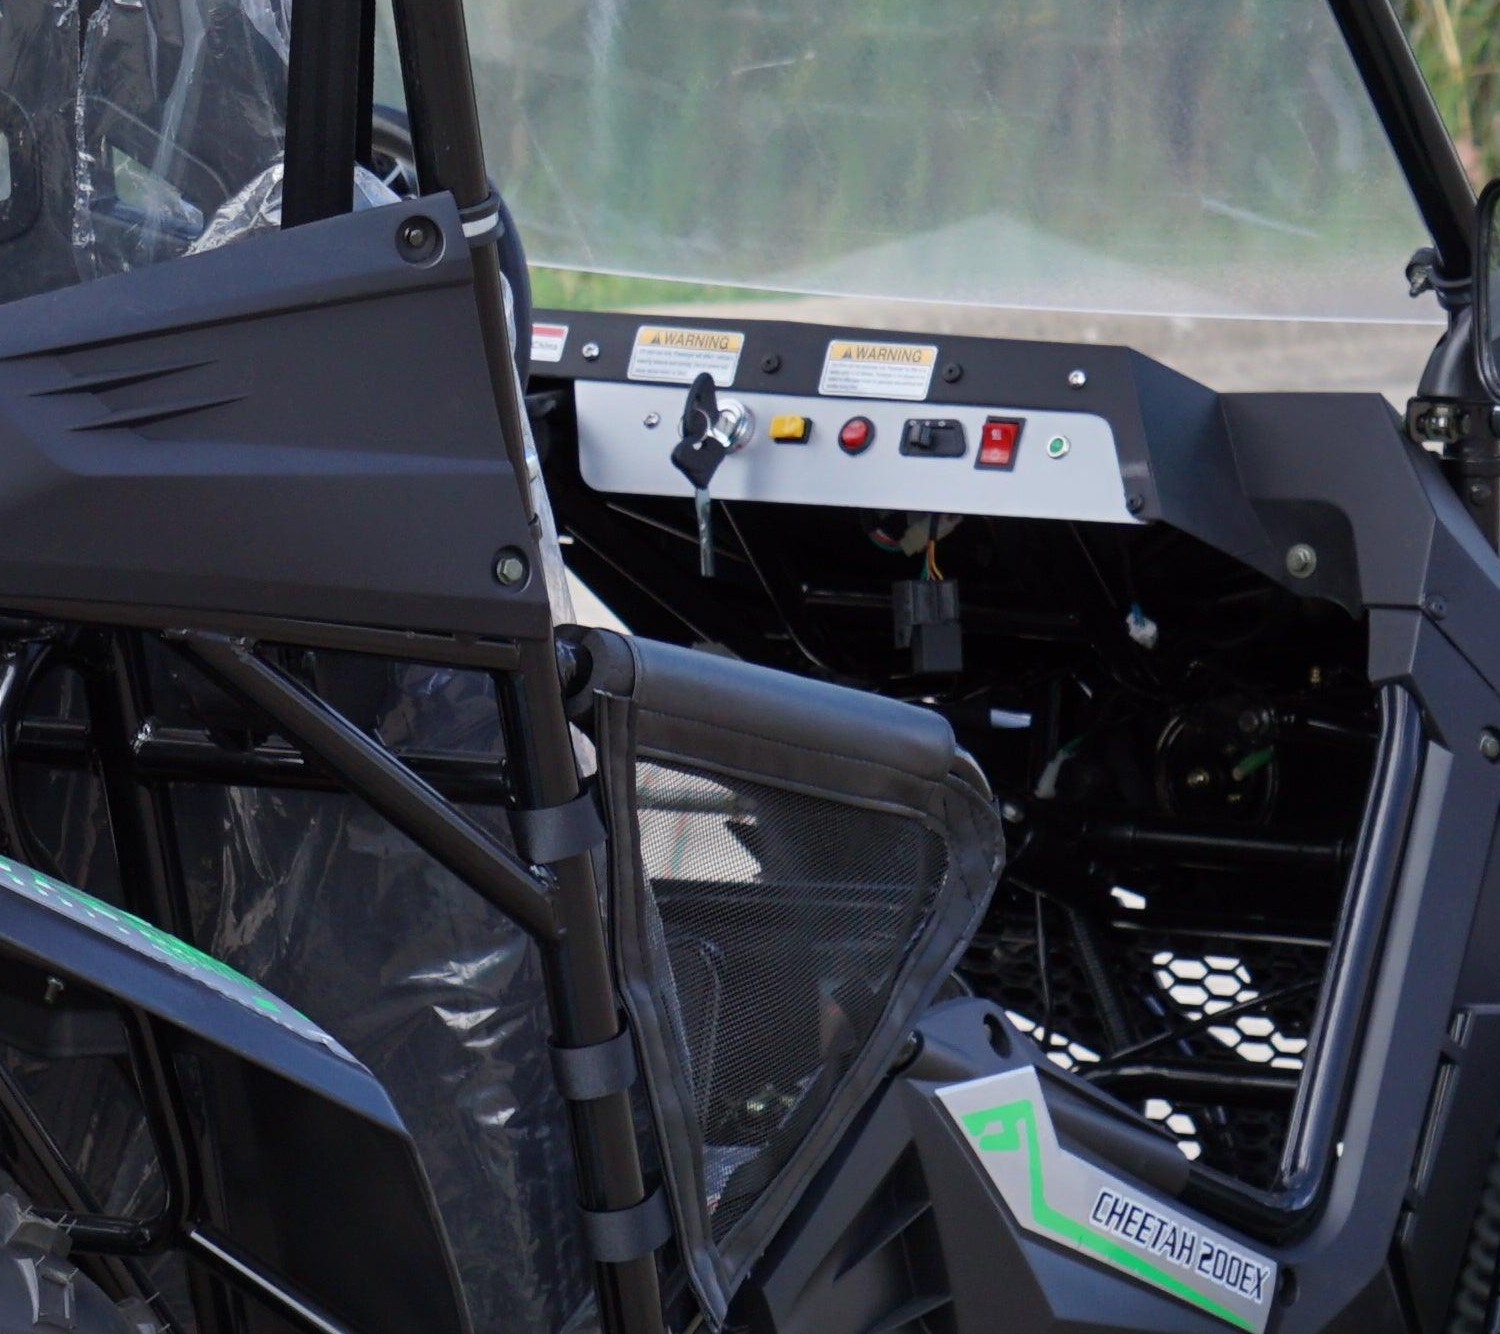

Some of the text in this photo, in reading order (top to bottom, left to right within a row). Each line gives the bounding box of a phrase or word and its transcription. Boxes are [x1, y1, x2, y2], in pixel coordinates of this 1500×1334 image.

[663, 332, 730, 350] WARNING
[855, 346, 922, 363] WARNING
[1091, 1191, 1269, 1300] CHEETAH 200EX
